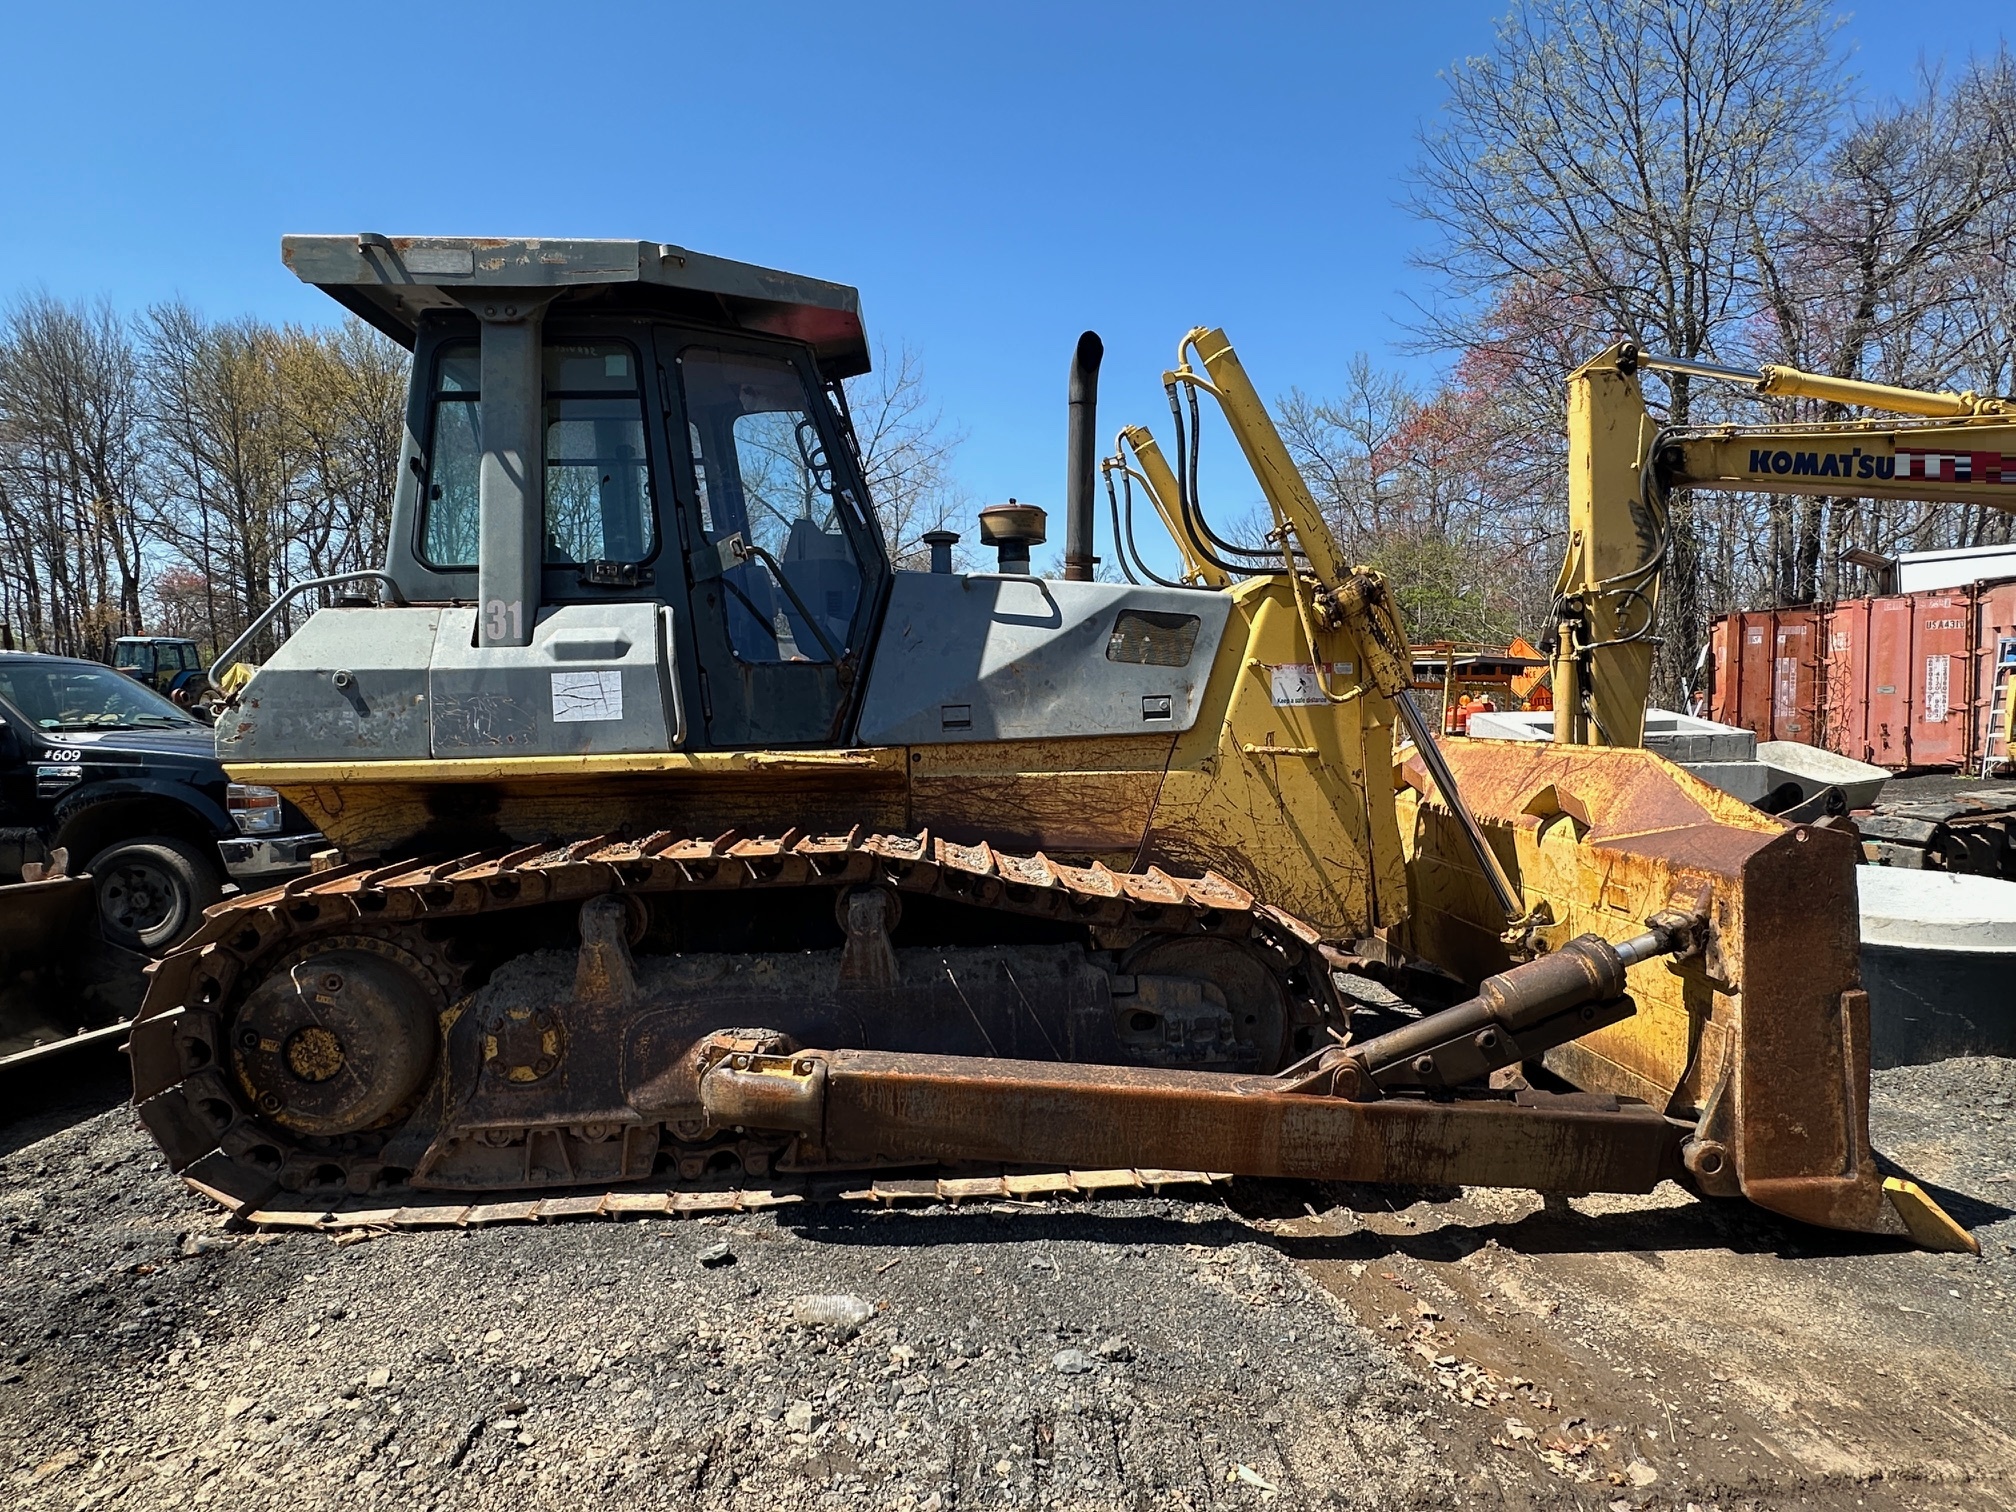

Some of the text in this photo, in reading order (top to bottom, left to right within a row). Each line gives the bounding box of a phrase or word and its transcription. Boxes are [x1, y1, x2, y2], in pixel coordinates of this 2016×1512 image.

[1749, 448, 1895, 480] KOMATSU
[485, 600, 523, 640] 31
[44, 750, 81, 761] #609
